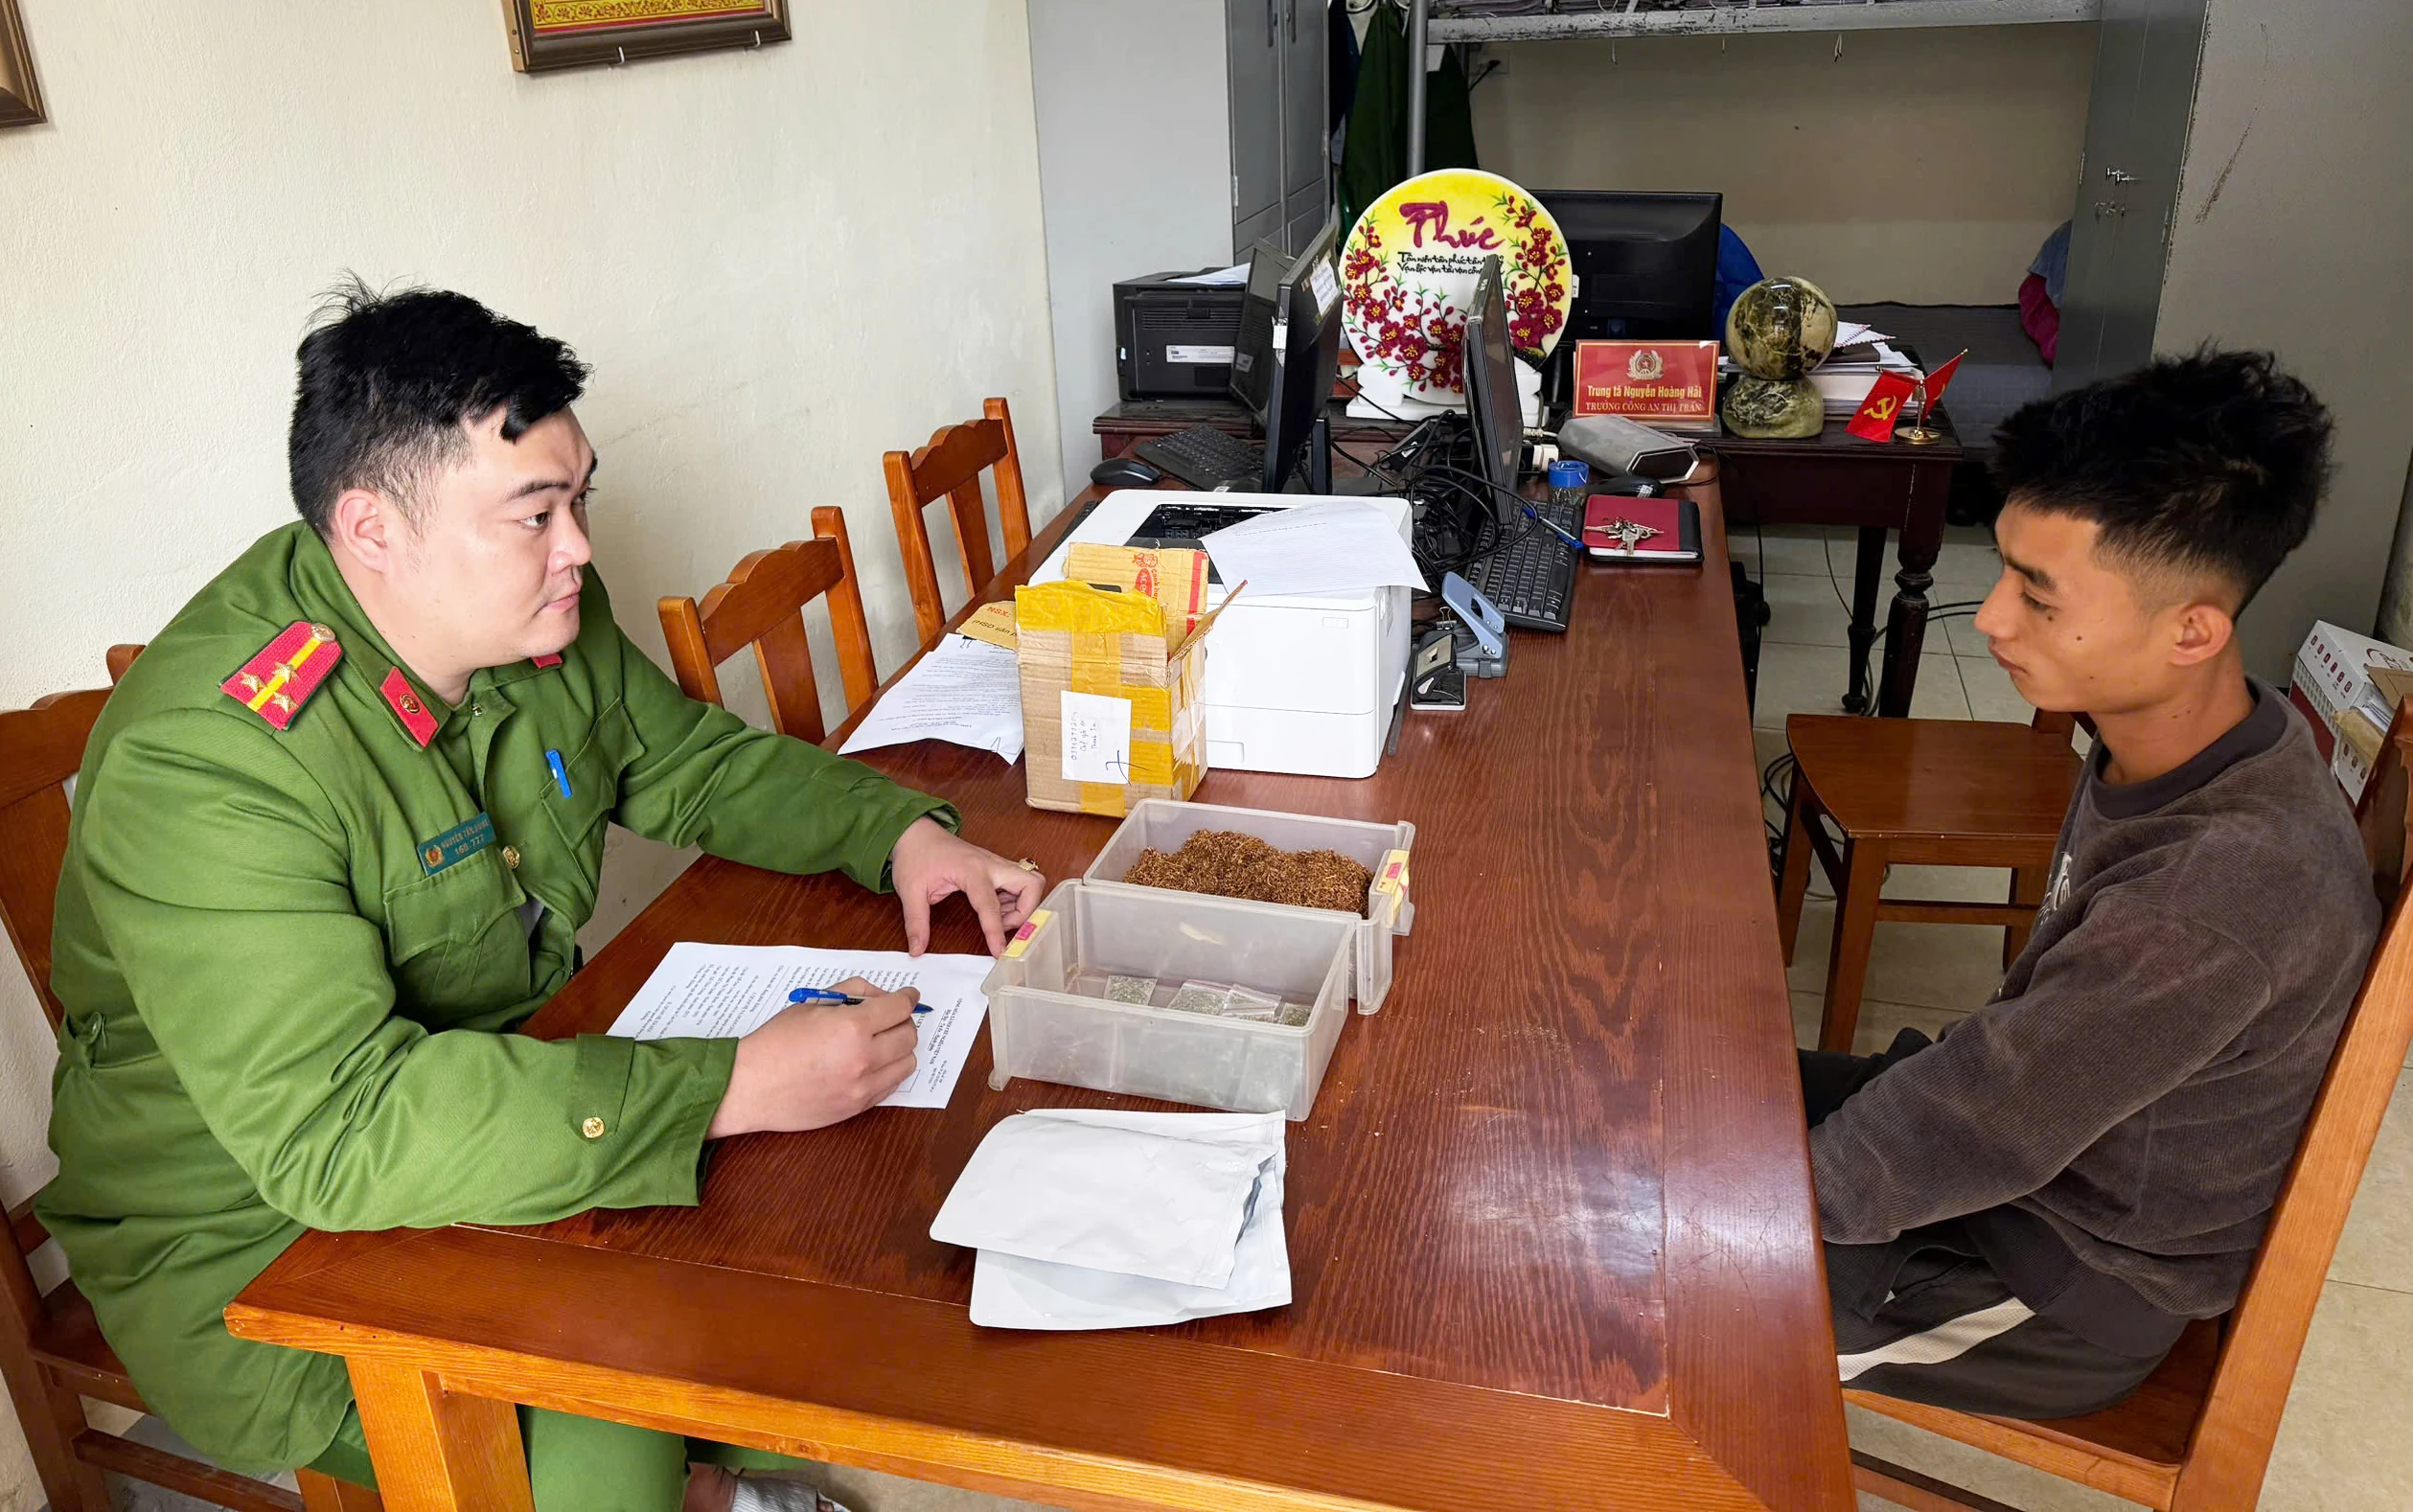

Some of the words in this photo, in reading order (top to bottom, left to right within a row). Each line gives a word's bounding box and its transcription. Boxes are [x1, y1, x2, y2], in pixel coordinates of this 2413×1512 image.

[1399, 200, 1505, 250] Phúc
[1397, 251, 1416, 263] Tân
[1448, 253, 1466, 268] phúc
[1587, 385, 1611, 398] Trung
[1613, 385, 1621, 397] tá
[1623, 383, 1656, 398] Nguyễn
[1658, 385, 1685, 398] Hoàng
[1586, 400, 1620, 411] TRƯỞNG
[1621, 401, 1645, 411] CÔNG
[1647, 402, 1661, 412] AN
